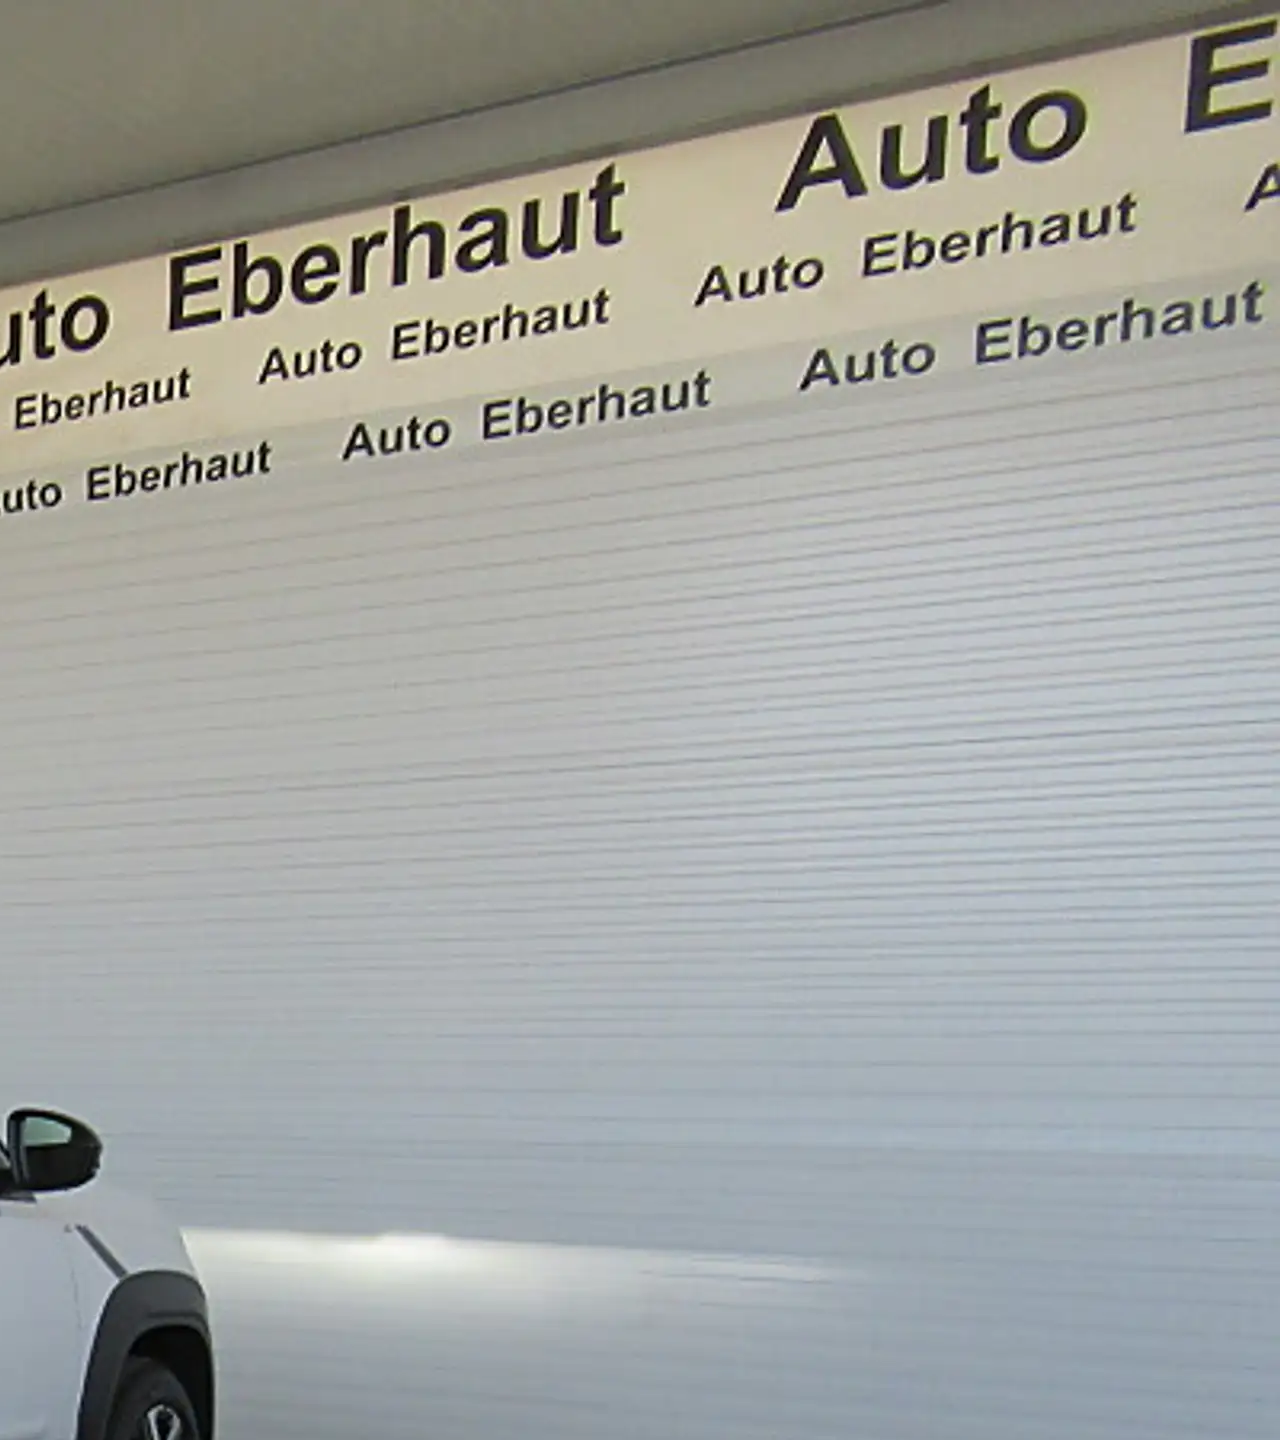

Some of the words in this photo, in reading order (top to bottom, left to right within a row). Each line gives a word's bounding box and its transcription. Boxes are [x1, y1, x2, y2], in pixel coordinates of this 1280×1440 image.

[774, 84, 1087, 213] Auto
[168, 164, 626, 332] Eberhaut
[694, 255, 826, 308] Auto
[862, 192, 1138, 278] Eberhaut
[258, 341, 363, 385] Auto
[391, 288, 611, 362] Eberhaut
[799, 338, 937, 392] Auto
[976, 280, 1264, 367] Eberhaut
[15, 366, 192, 430] Eberhaut
[342, 408, 452, 462] Auto
[482, 370, 712, 440] Eberhaut
[87, 440, 272, 502] Eberhaut
